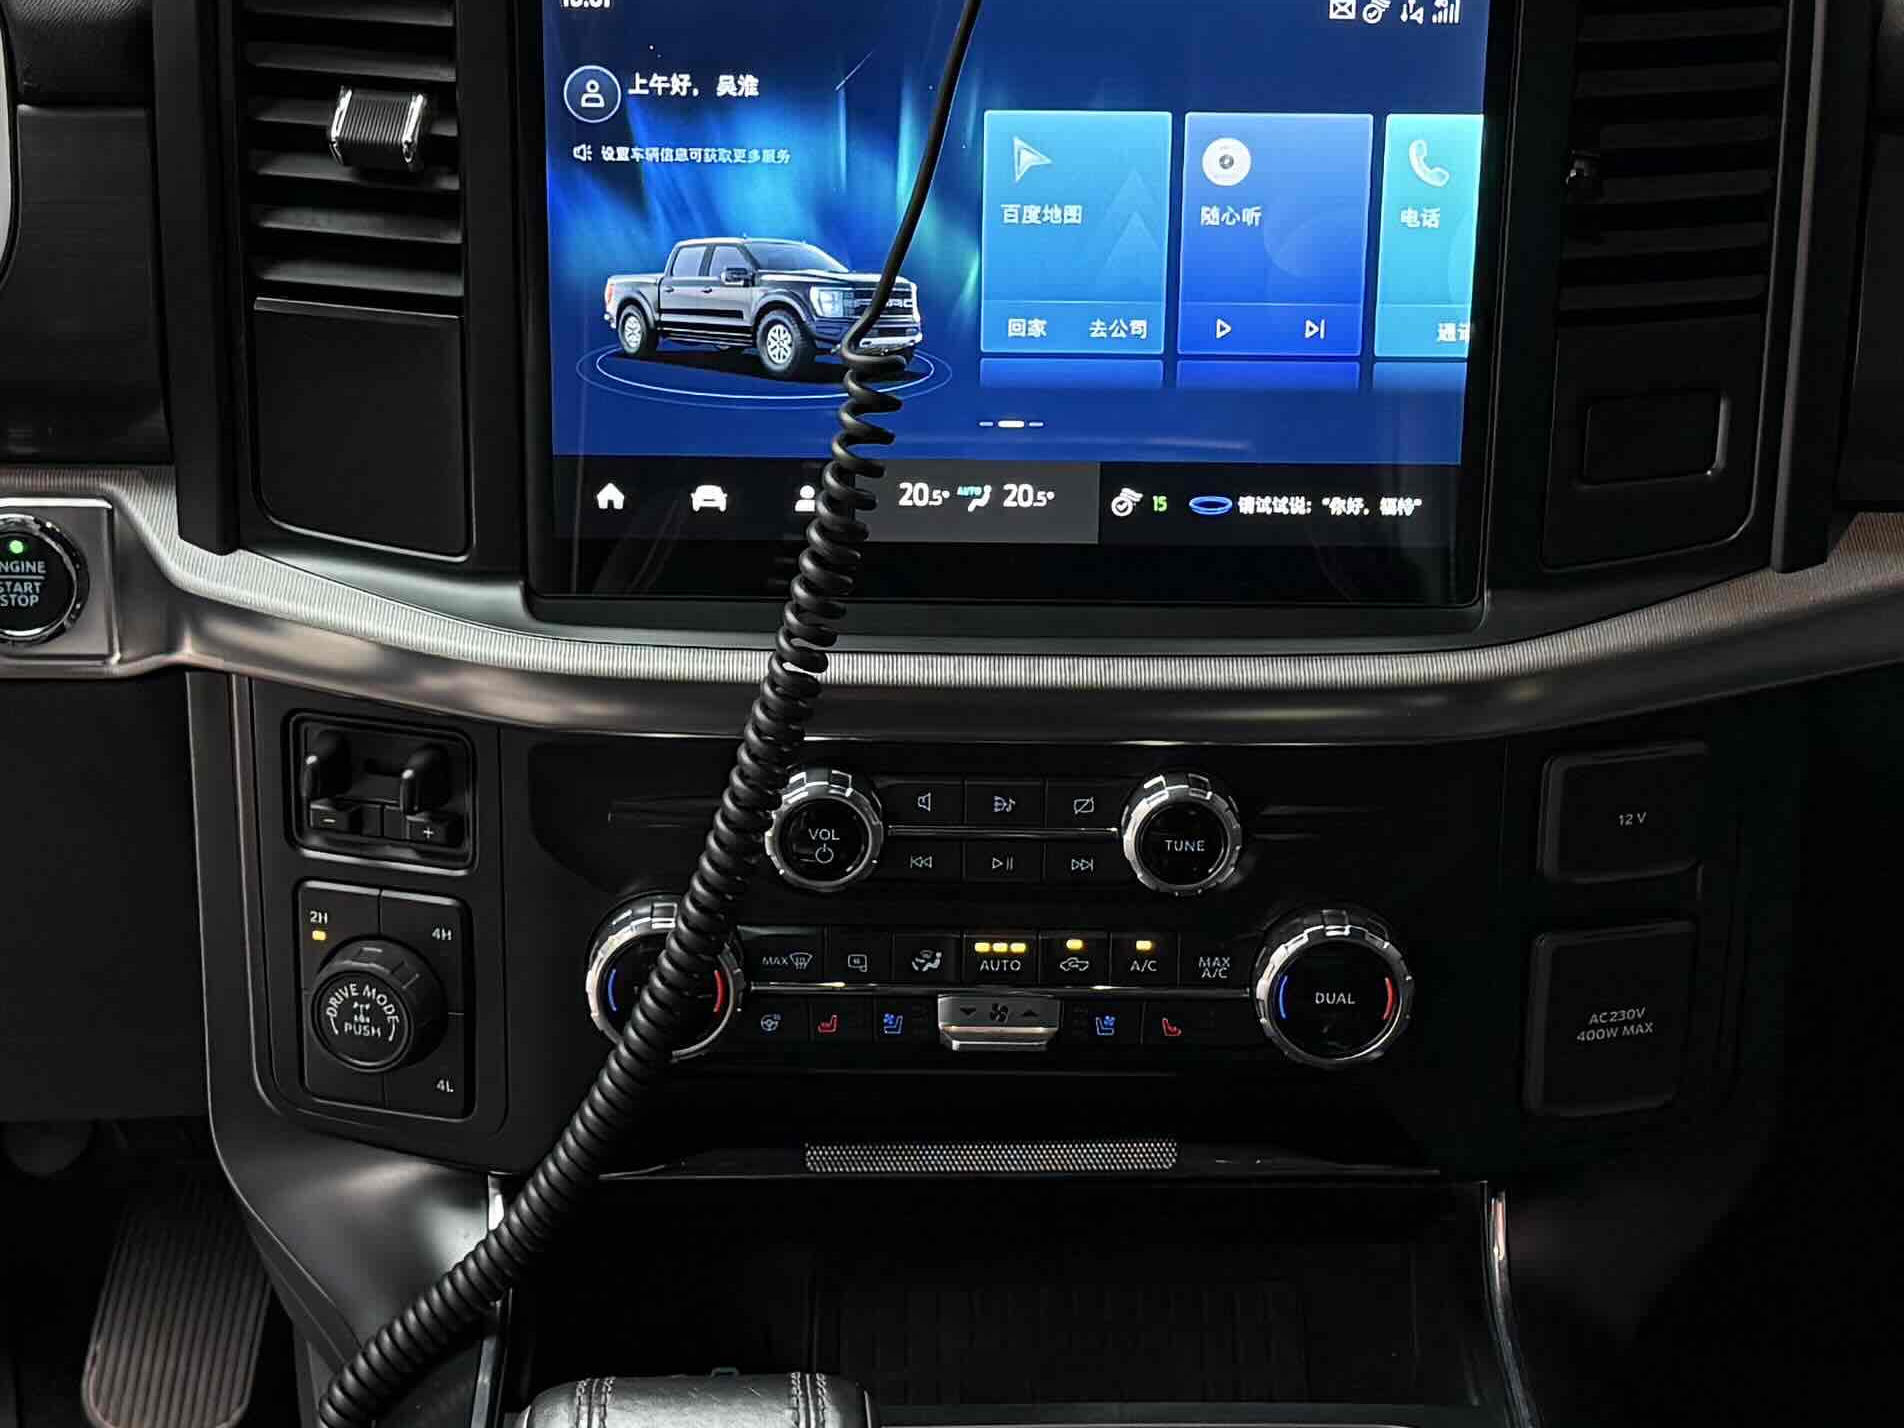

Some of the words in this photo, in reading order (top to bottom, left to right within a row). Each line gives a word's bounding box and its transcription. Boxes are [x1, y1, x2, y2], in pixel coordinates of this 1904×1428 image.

[1000, 203, 1084, 227] 百度地图
[1200, 205, 1262, 228] 随心听
[1400, 207, 1441, 229] 电话
[1007, 317, 1048, 339] 回家
[1089, 317, 1149, 340] 去公司
[957, 486, 982, 497] AUTO
[1152, 495, 1168, 512] 15
[0, 594, 40, 607] STOP
[1618, 813, 1633, 826] 12
[1637, 811, 1647, 824] V
[808, 828, 840, 841] VOL
[1164, 839, 1206, 852] TUNE
[309, 911, 329, 925] 2H
[431, 928, 453, 941] 4H
[762, 956, 789, 966] MAX
[980, 960, 1021, 972] AUTO
[1130, 960, 1157, 973] A/C
[1198, 956, 1231, 968] MAX
[1201, 967, 1228, 979] A/C
[326, 983, 358, 1018] DRIVE
[363, 984, 400, 1024] MODE
[1315, 992, 1356, 1005] DUAL
[344, 1022, 382, 1038] PUSH
[1577, 1027, 1619, 1042] 400W
[1622, 1022, 1655, 1037] MAX
[436, 1079, 454, 1093] 4L
